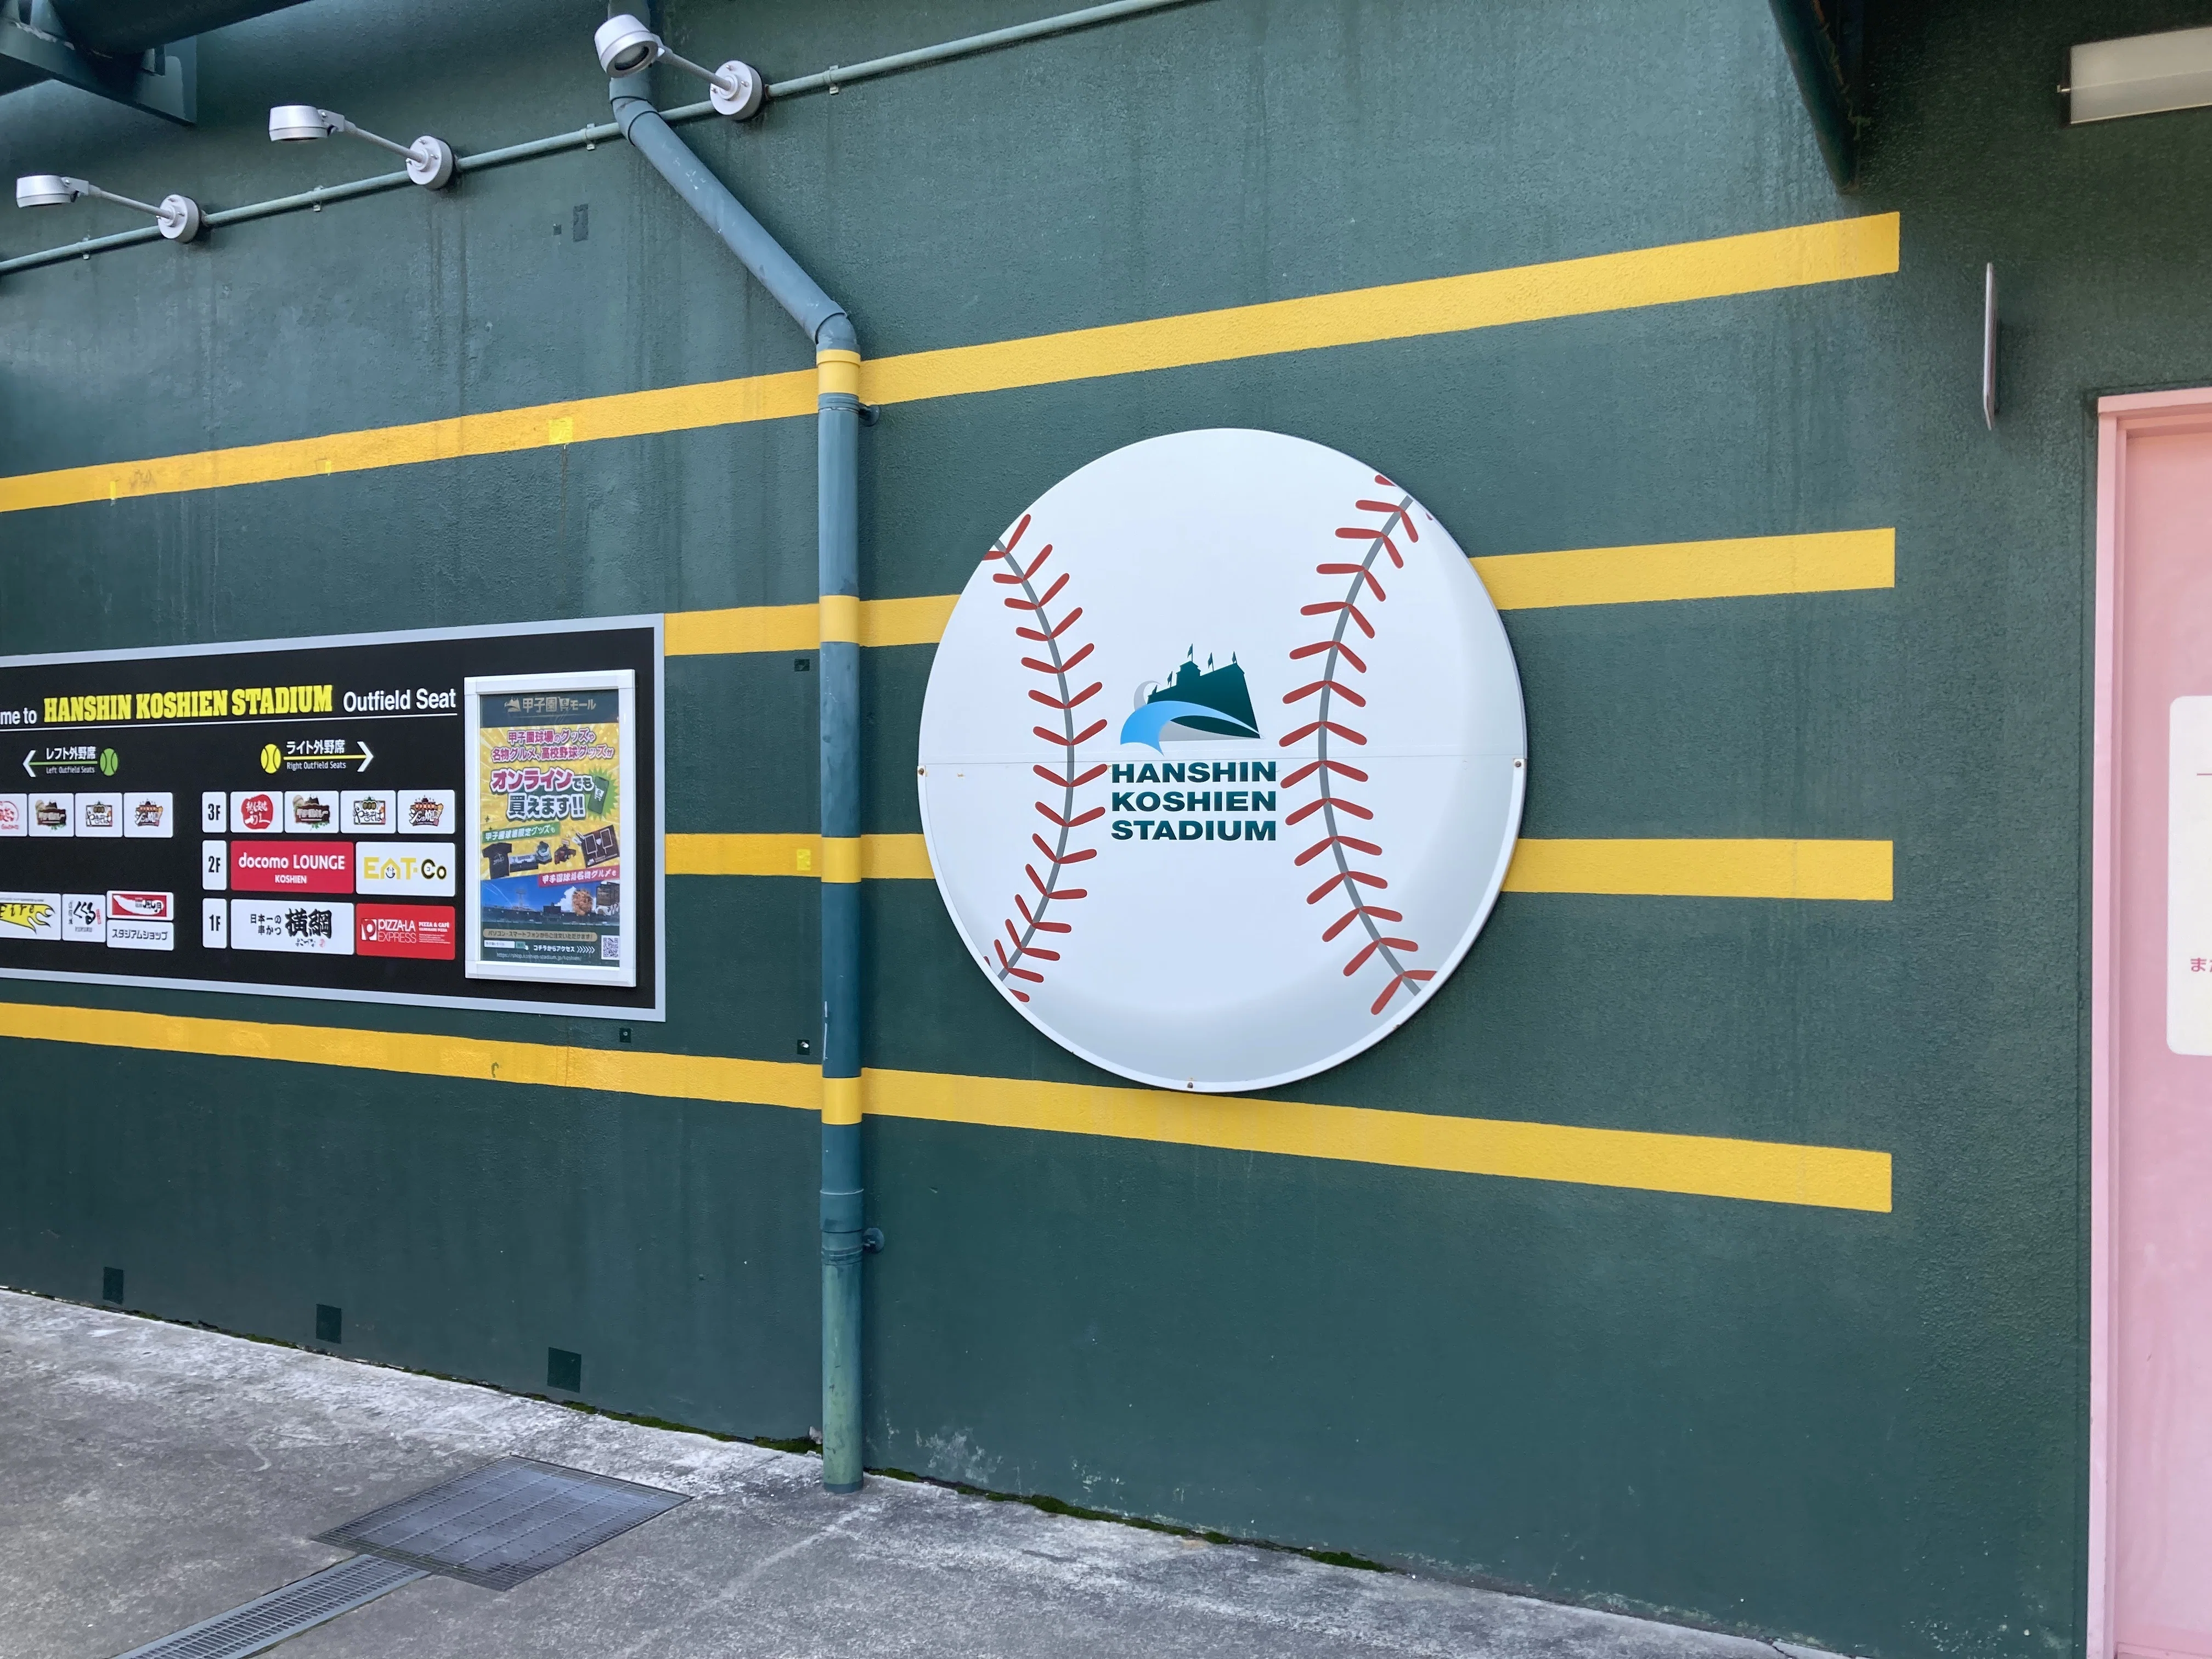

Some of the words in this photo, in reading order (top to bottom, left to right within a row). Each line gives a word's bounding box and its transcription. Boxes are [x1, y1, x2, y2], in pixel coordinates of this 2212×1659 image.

[23, 707, 37, 724] to
[44, 694, 132, 723] HANSHIN
[136, 689, 228, 719] KOSHIEN
[232, 685, 332, 715] STADIUM
[343, 690, 410, 712] Outfield
[416, 688, 456, 709] Seat
[46, 746, 96, 760] レフト外野席
[286, 740, 345, 754] ライト外野席
[286, 762, 302, 771] Right
[330, 761, 346, 769] Seats
[1111, 761, 1276, 783] HANSHIN
[492, 768, 594, 790] オンラインでも
[1111, 791, 1276, 812] KOSHIEN
[208, 803, 221, 821] 3F
[1111, 820, 1276, 841] STADIUM
[208, 855, 221, 873] 2F
[238, 852, 289, 868] docomo
[292, 854, 345, 870] LOUNGE
[274, 874, 307, 884] KOSHIEN
[208, 914, 221, 931] 1F
[250, 913, 281, 924] 日本一の
[285, 907, 332, 939] 横綱
[378, 919, 416, 932] PIZZA-LA
[112, 929, 168, 940] スタジアムショップ
[258, 925, 281, 936] 串かつ
[377, 931, 417, 944] EXPRESS
